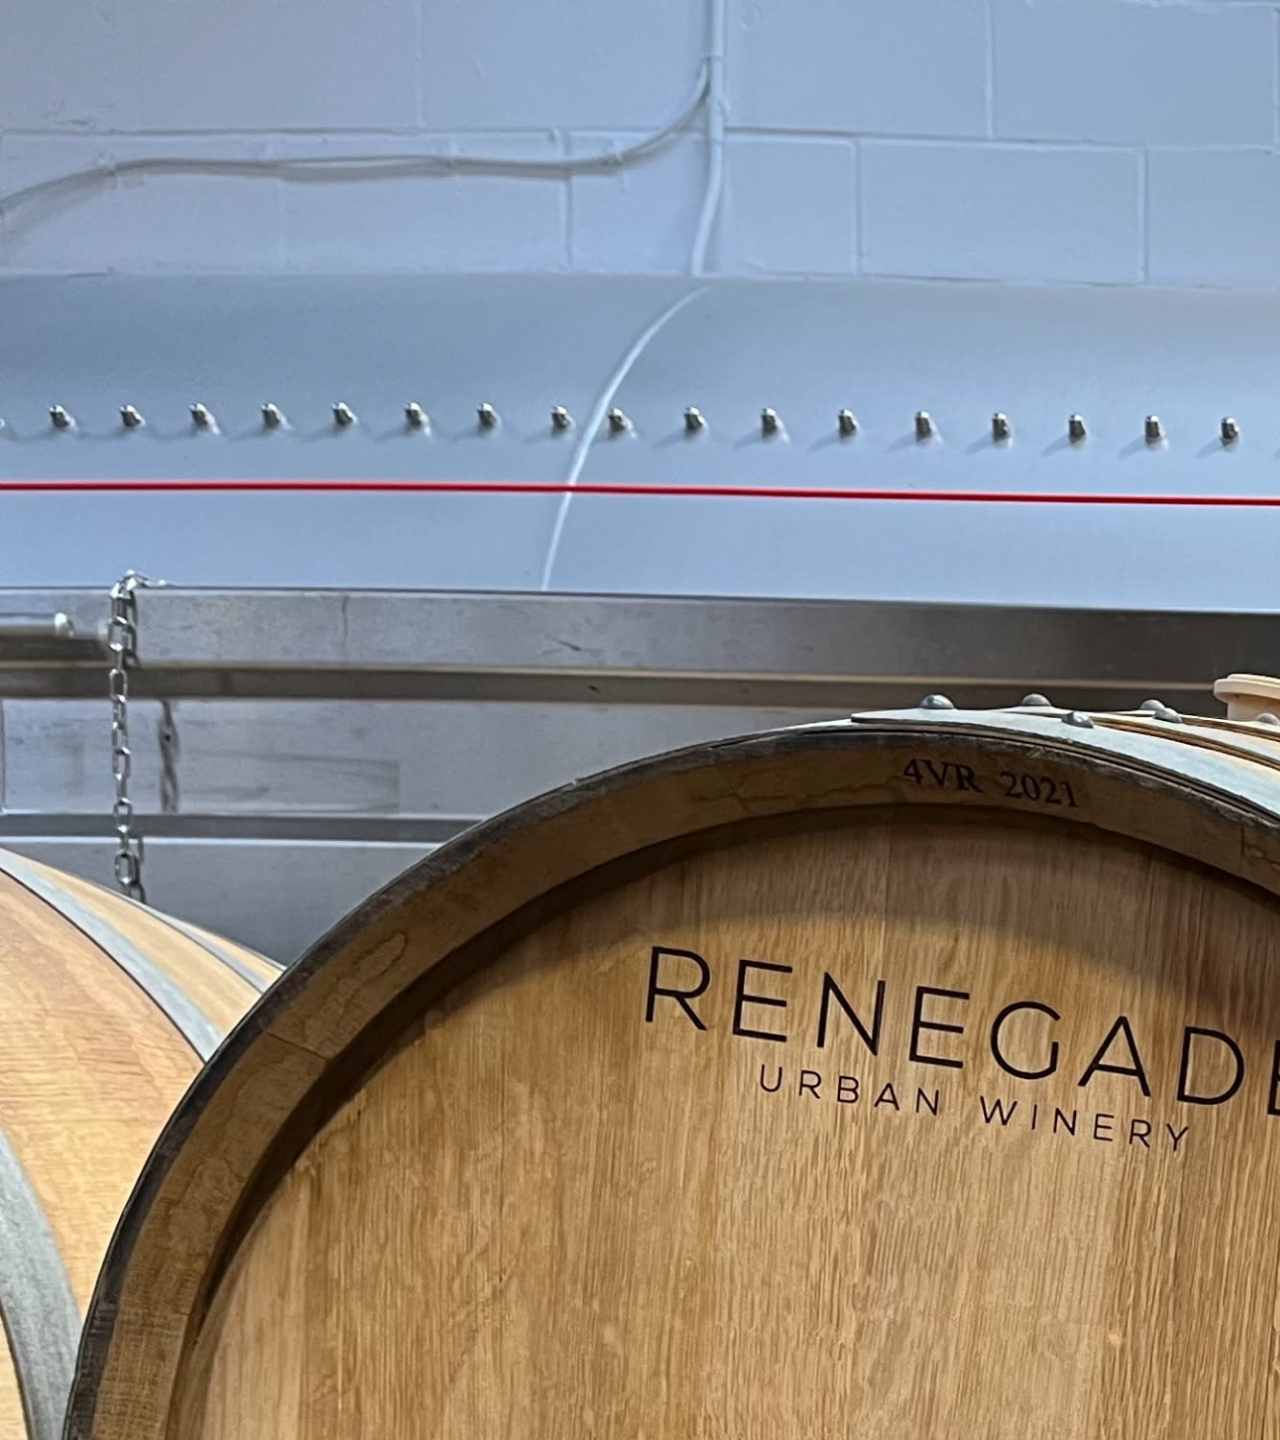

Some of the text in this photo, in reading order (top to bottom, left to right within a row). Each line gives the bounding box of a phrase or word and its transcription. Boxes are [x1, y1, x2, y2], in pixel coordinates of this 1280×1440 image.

[903, 757, 1080, 808] 4VR 2021
[759, 1063, 1190, 1152] URBAN WINERY
